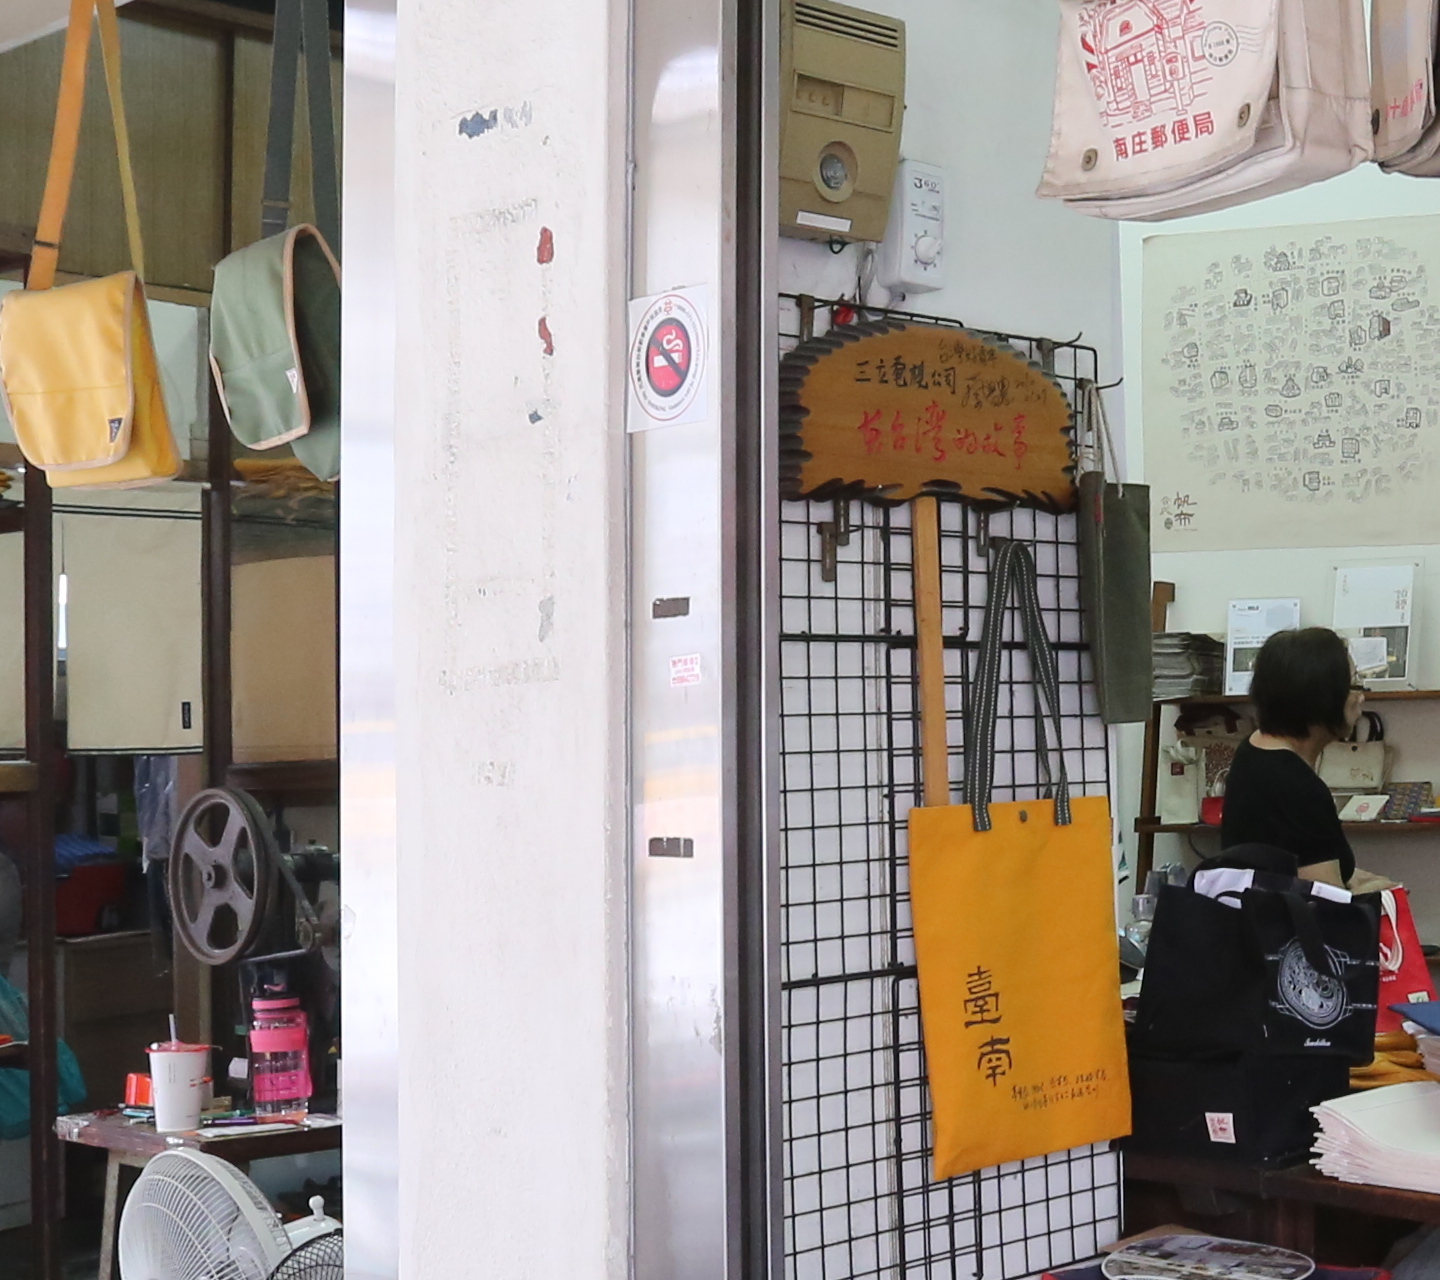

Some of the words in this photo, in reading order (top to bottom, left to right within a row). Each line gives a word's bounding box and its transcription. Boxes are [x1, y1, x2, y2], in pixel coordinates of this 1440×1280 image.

[1113, 112, 1215, 161] 南庄郵便局
[962, 965, 1013, 1087] 臺南
